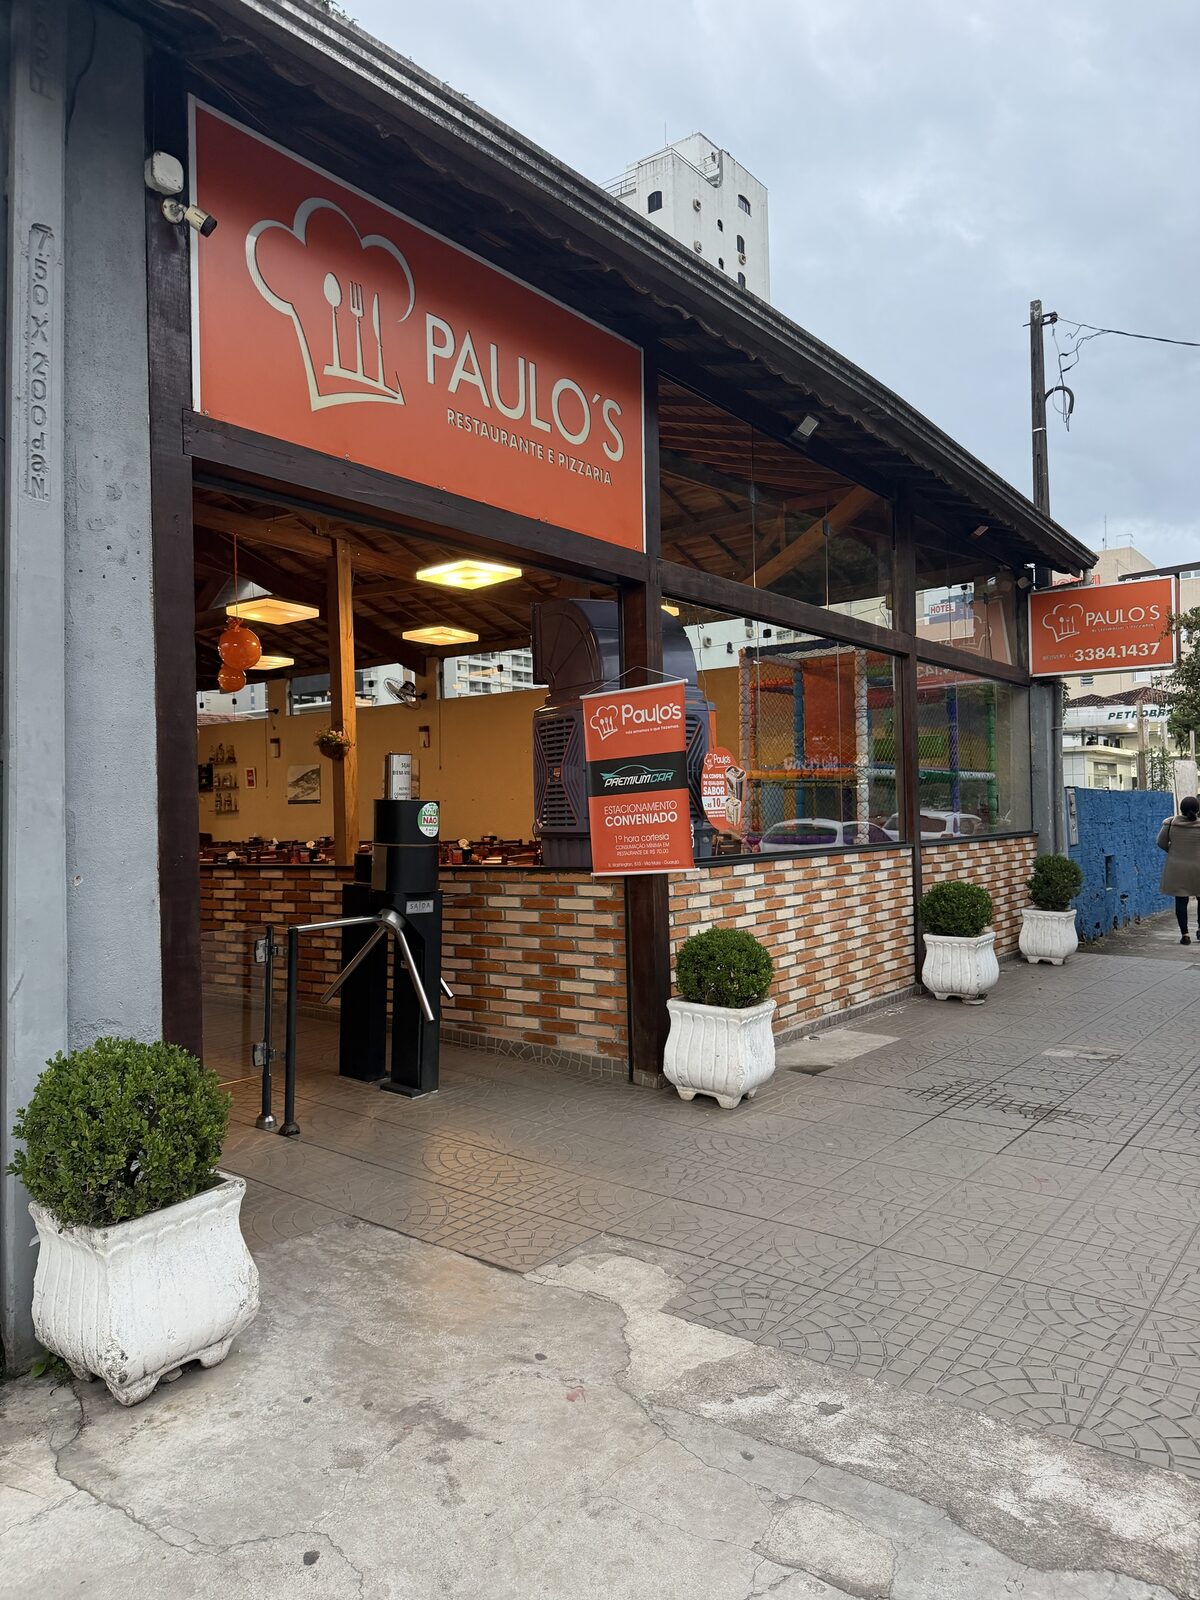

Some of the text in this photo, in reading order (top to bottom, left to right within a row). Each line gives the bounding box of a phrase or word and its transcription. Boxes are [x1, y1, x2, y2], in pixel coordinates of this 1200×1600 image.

[447, 408, 613, 486] RESTAURANTE E PIZZARIA
[930, 604, 954, 614] HOTEL
[1074, 642, 1160, 662] 3384.1437
[703, 786, 725, 796] SABOR
[604, 800, 677, 815] ESTACIONAMENTO
[605, 811, 678, 827] CONVENIADO
[623, 835, 640, 843] hora
[641, 833, 670, 842] cortesia
